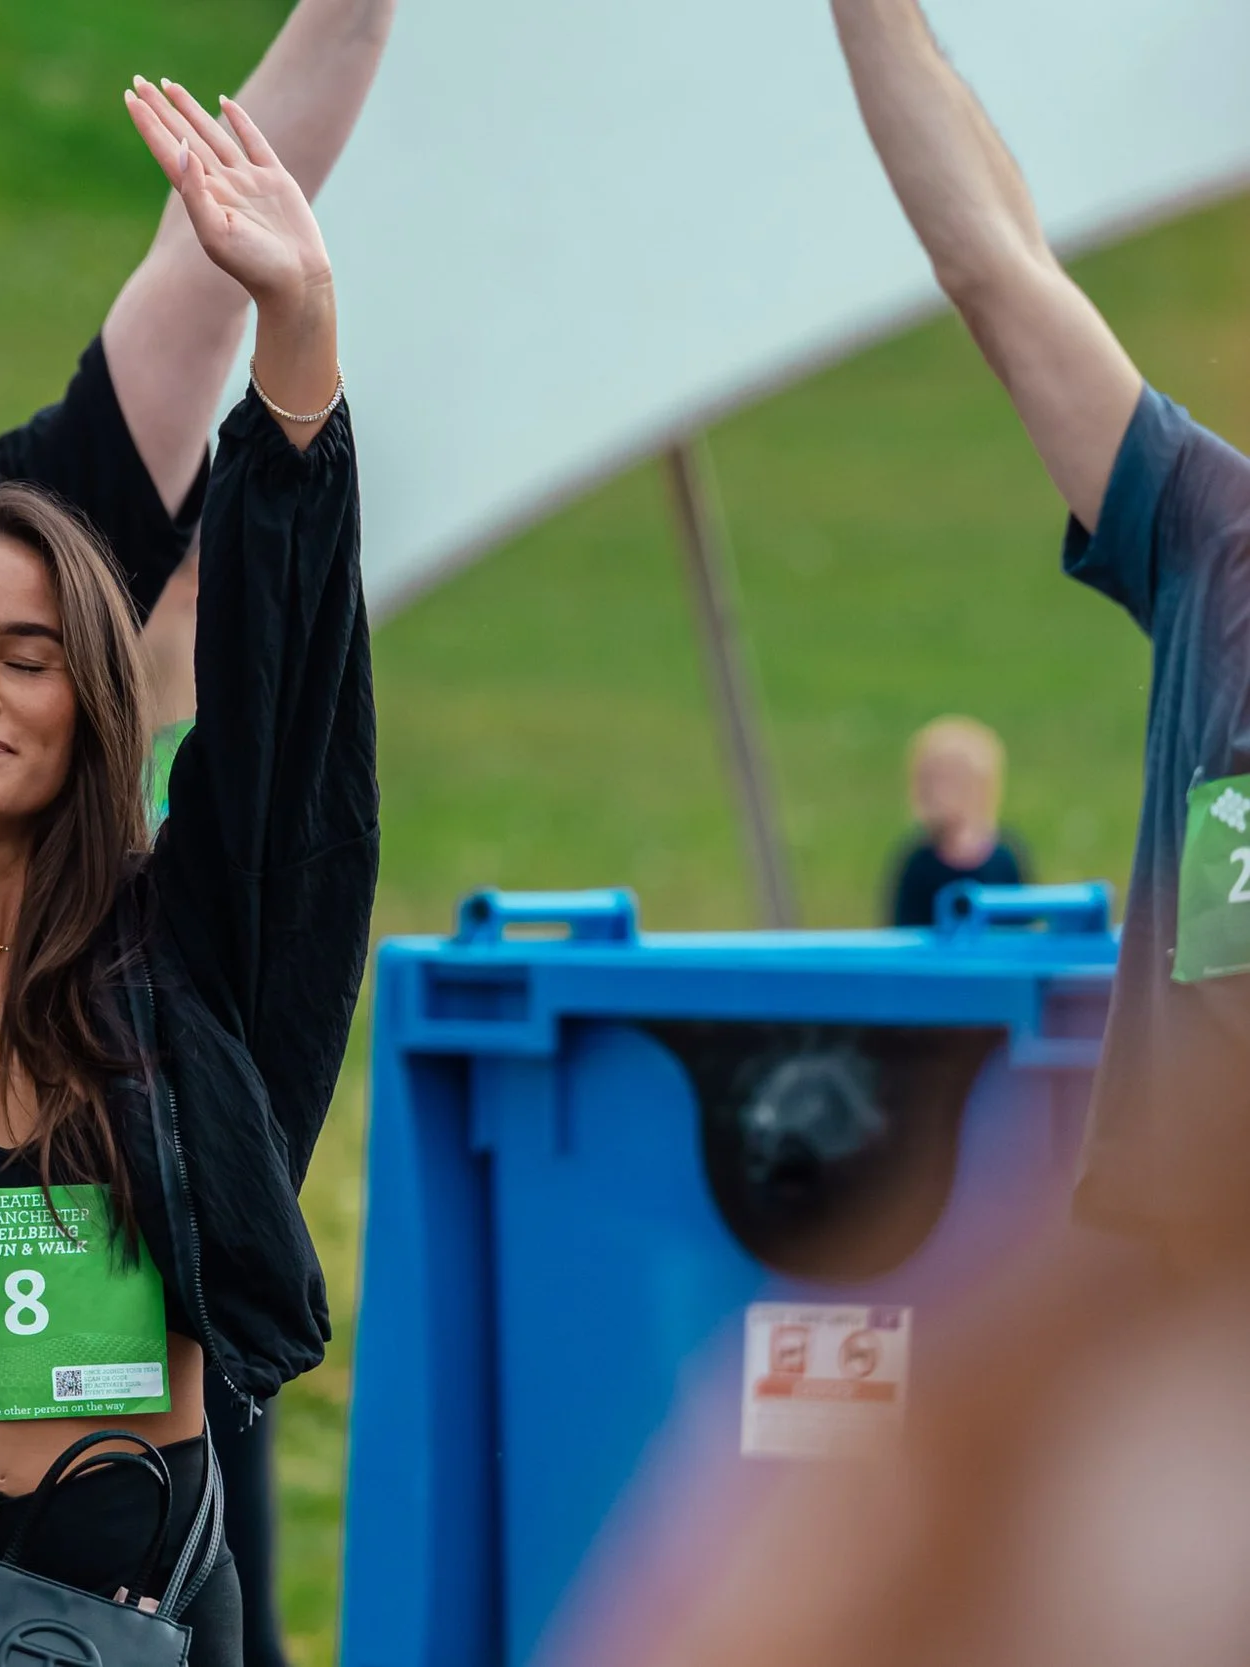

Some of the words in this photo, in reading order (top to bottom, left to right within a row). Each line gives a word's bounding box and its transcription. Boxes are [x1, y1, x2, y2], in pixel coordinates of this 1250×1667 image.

[21, 1243, 33, 1256] &
[37, 1240, 88, 1255] WALK
[4, 1404, 32, 1415] other
[34, 1404, 69, 1417] person
[71, 1404, 84, 1413] on
[86, 1401, 103, 1411] the
[105, 1402, 125, 1412] way
